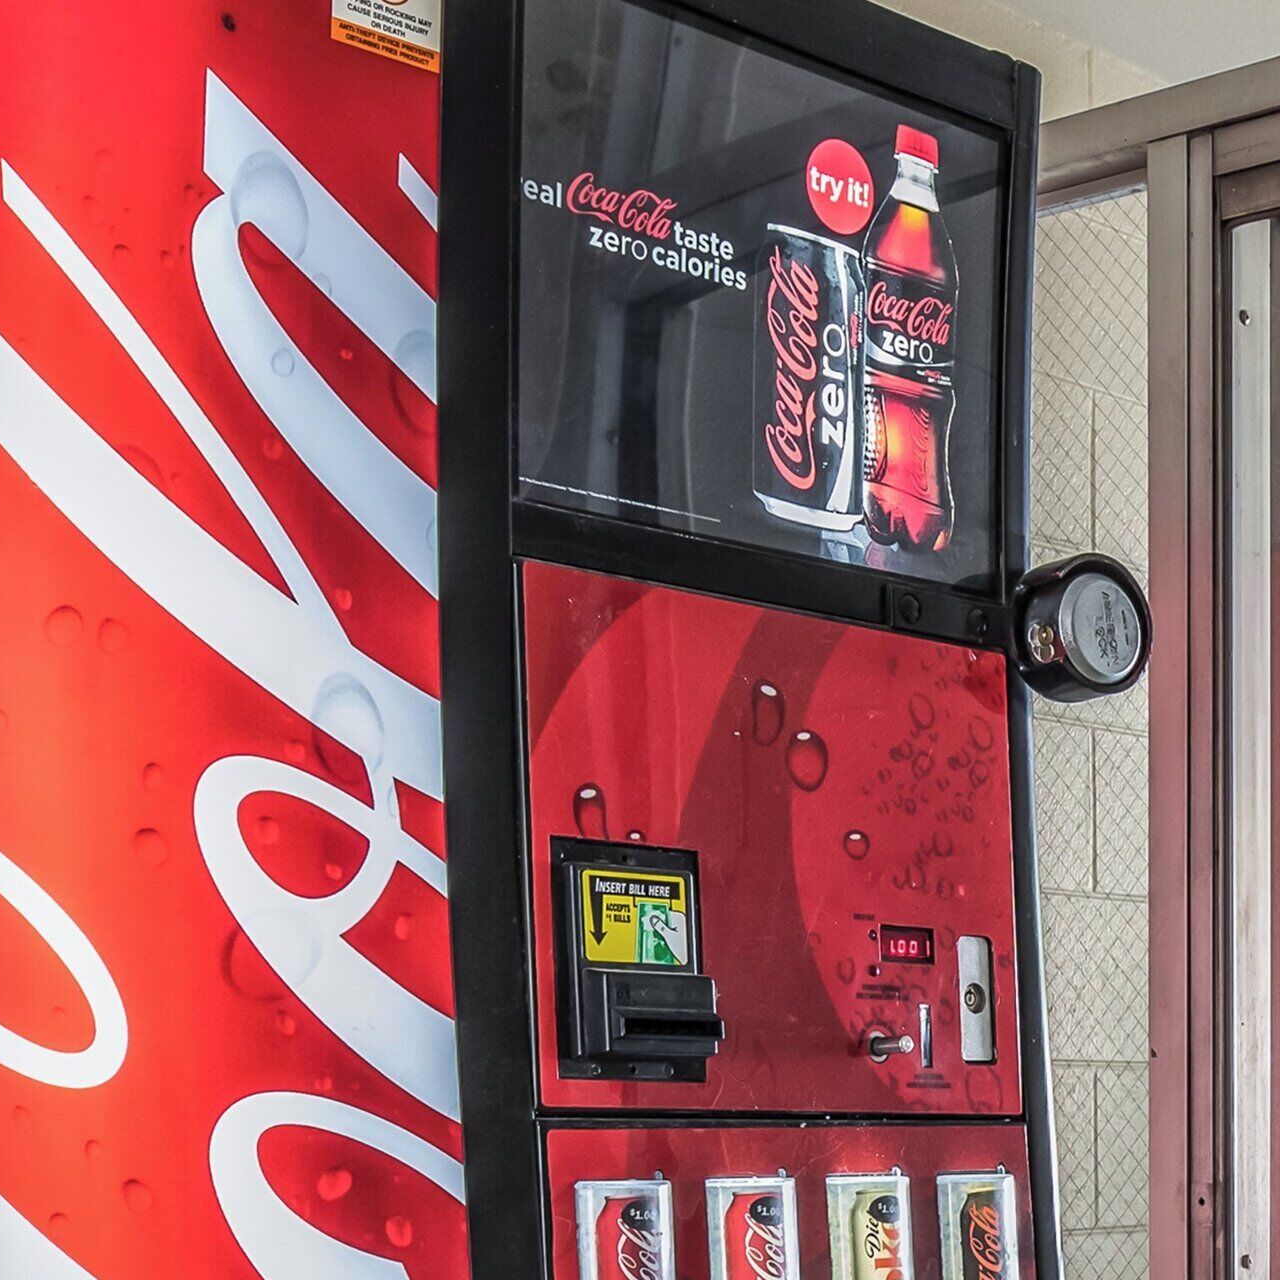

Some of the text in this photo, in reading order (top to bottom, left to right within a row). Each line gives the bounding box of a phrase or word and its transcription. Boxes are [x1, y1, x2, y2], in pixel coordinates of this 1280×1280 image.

[347, 3, 429, 36] CAUSE SERIOUS INJURY
[382, 23, 406, 38] DEATH
[809, 166, 869, 208] try it!
[521, 172, 734, 261] eal Coca-Cola taste
[589, 226, 747, 291] zero calories
[868, 281, 953, 346] Coca-Cola
[882, 330, 933, 364] zero
[765, 245, 820, 490] Coca-Cola
[822, 323, 846, 449] zero
[606, 903, 631, 913] ACCEPTS
[628, 883, 646, 896] BILL
[648, 884, 670, 898] HERE
[613, 914, 631, 923] BILLS
[877, 1202, 897, 1215] $1.0
[864, 1215, 883, 1259] Die
